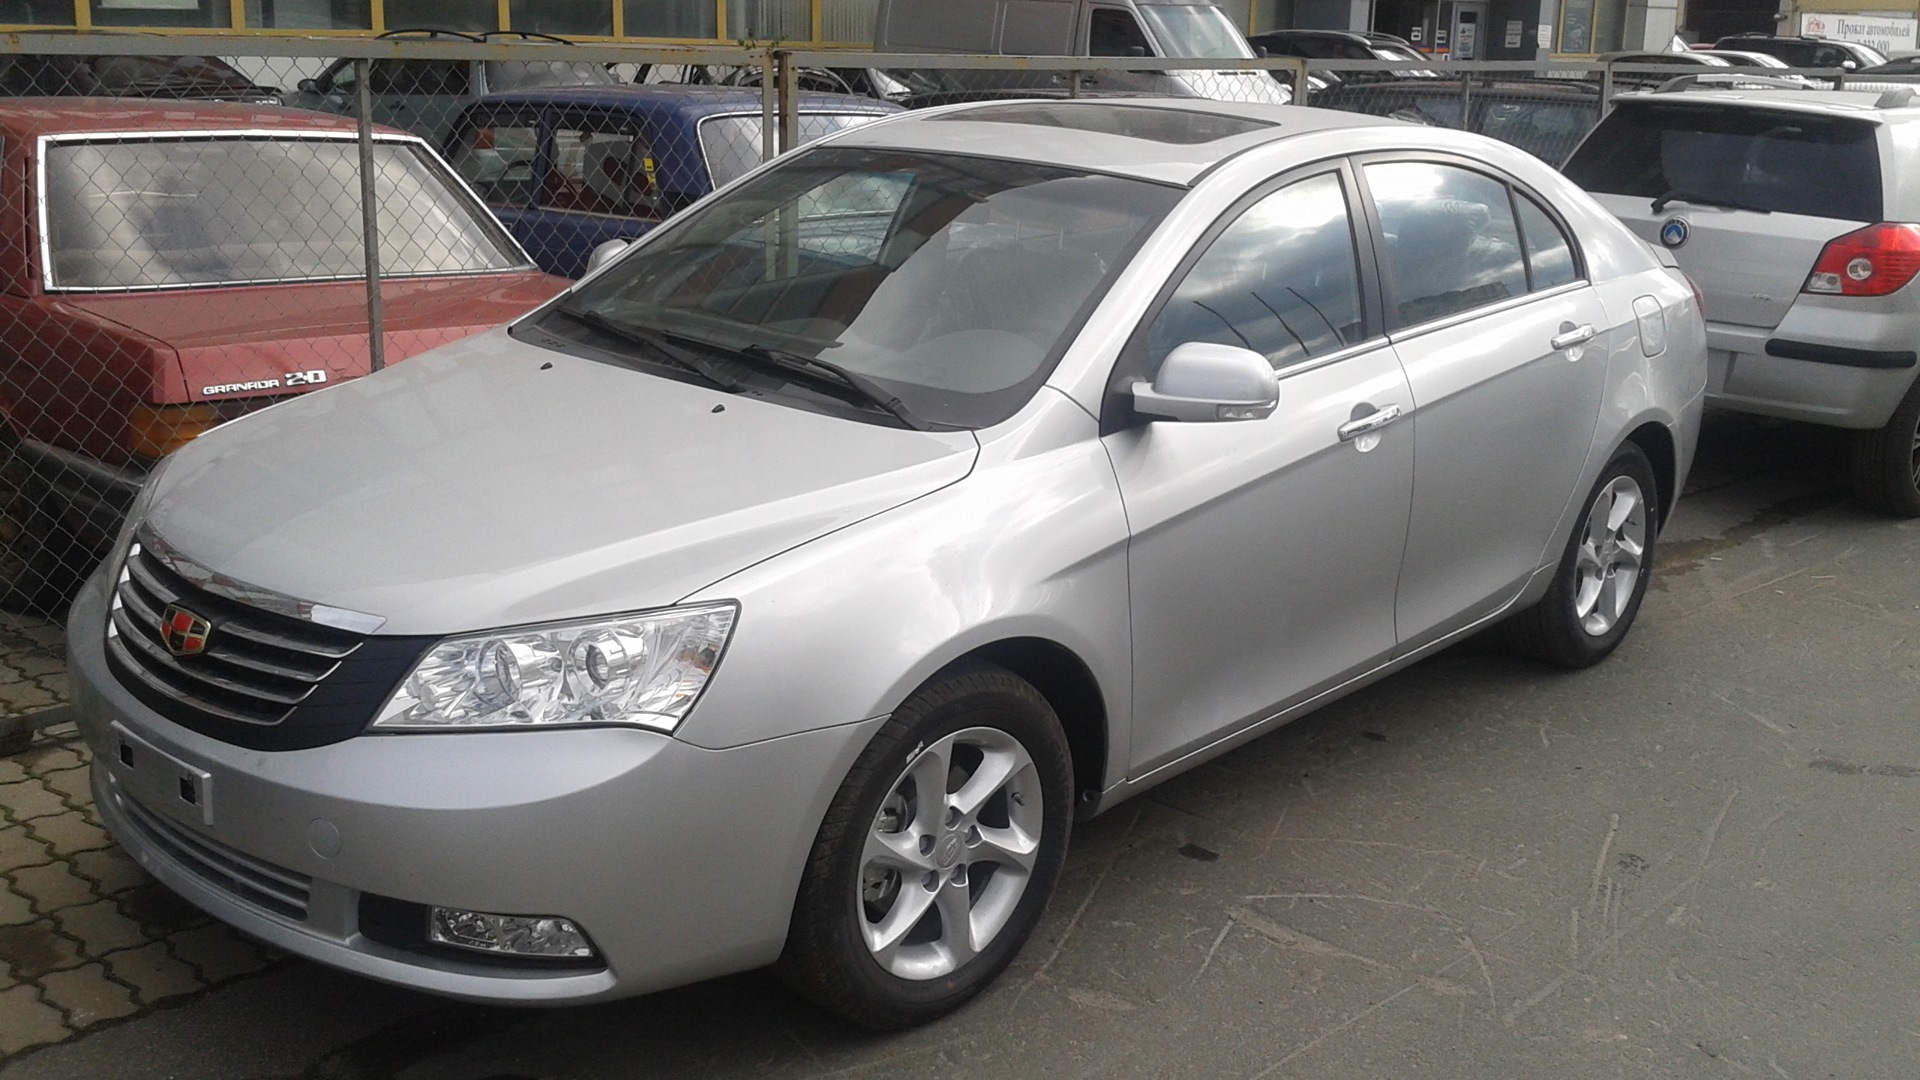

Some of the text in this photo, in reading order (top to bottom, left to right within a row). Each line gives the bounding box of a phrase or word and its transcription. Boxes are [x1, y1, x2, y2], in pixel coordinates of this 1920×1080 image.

[1837, 19, 1911, 39] Прокат автомобилей
[202, 369, 327, 395] GRANADA 2.0
